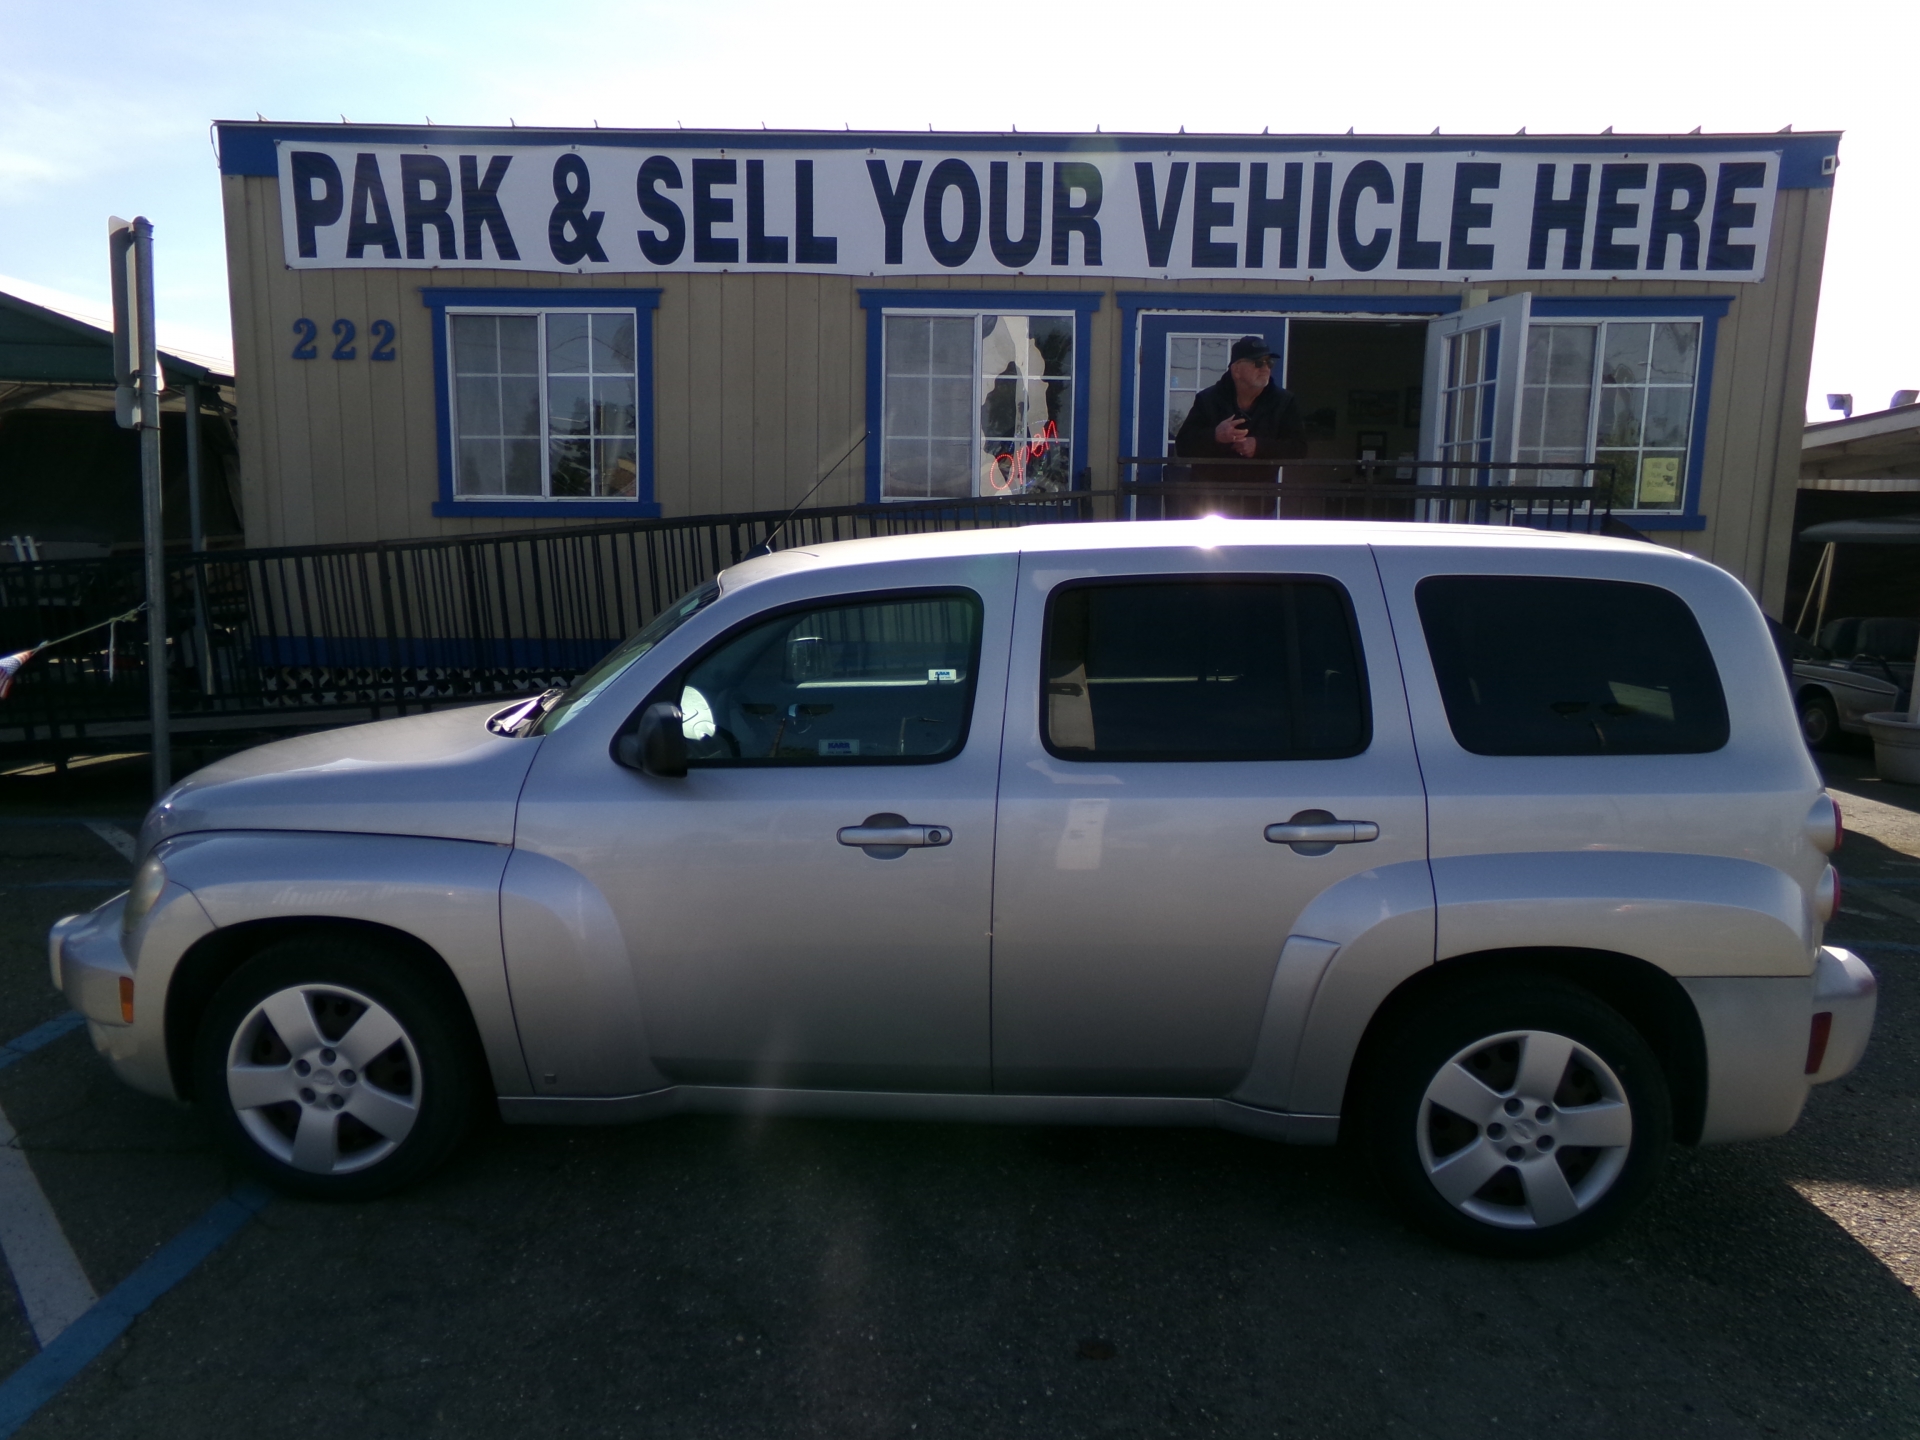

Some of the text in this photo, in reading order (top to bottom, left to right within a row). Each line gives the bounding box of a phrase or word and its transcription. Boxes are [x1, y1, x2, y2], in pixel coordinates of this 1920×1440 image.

[290, 151, 1767, 272] PARK & SELL YOUR VEHICLE HERE
[292, 318, 396, 361] 222
